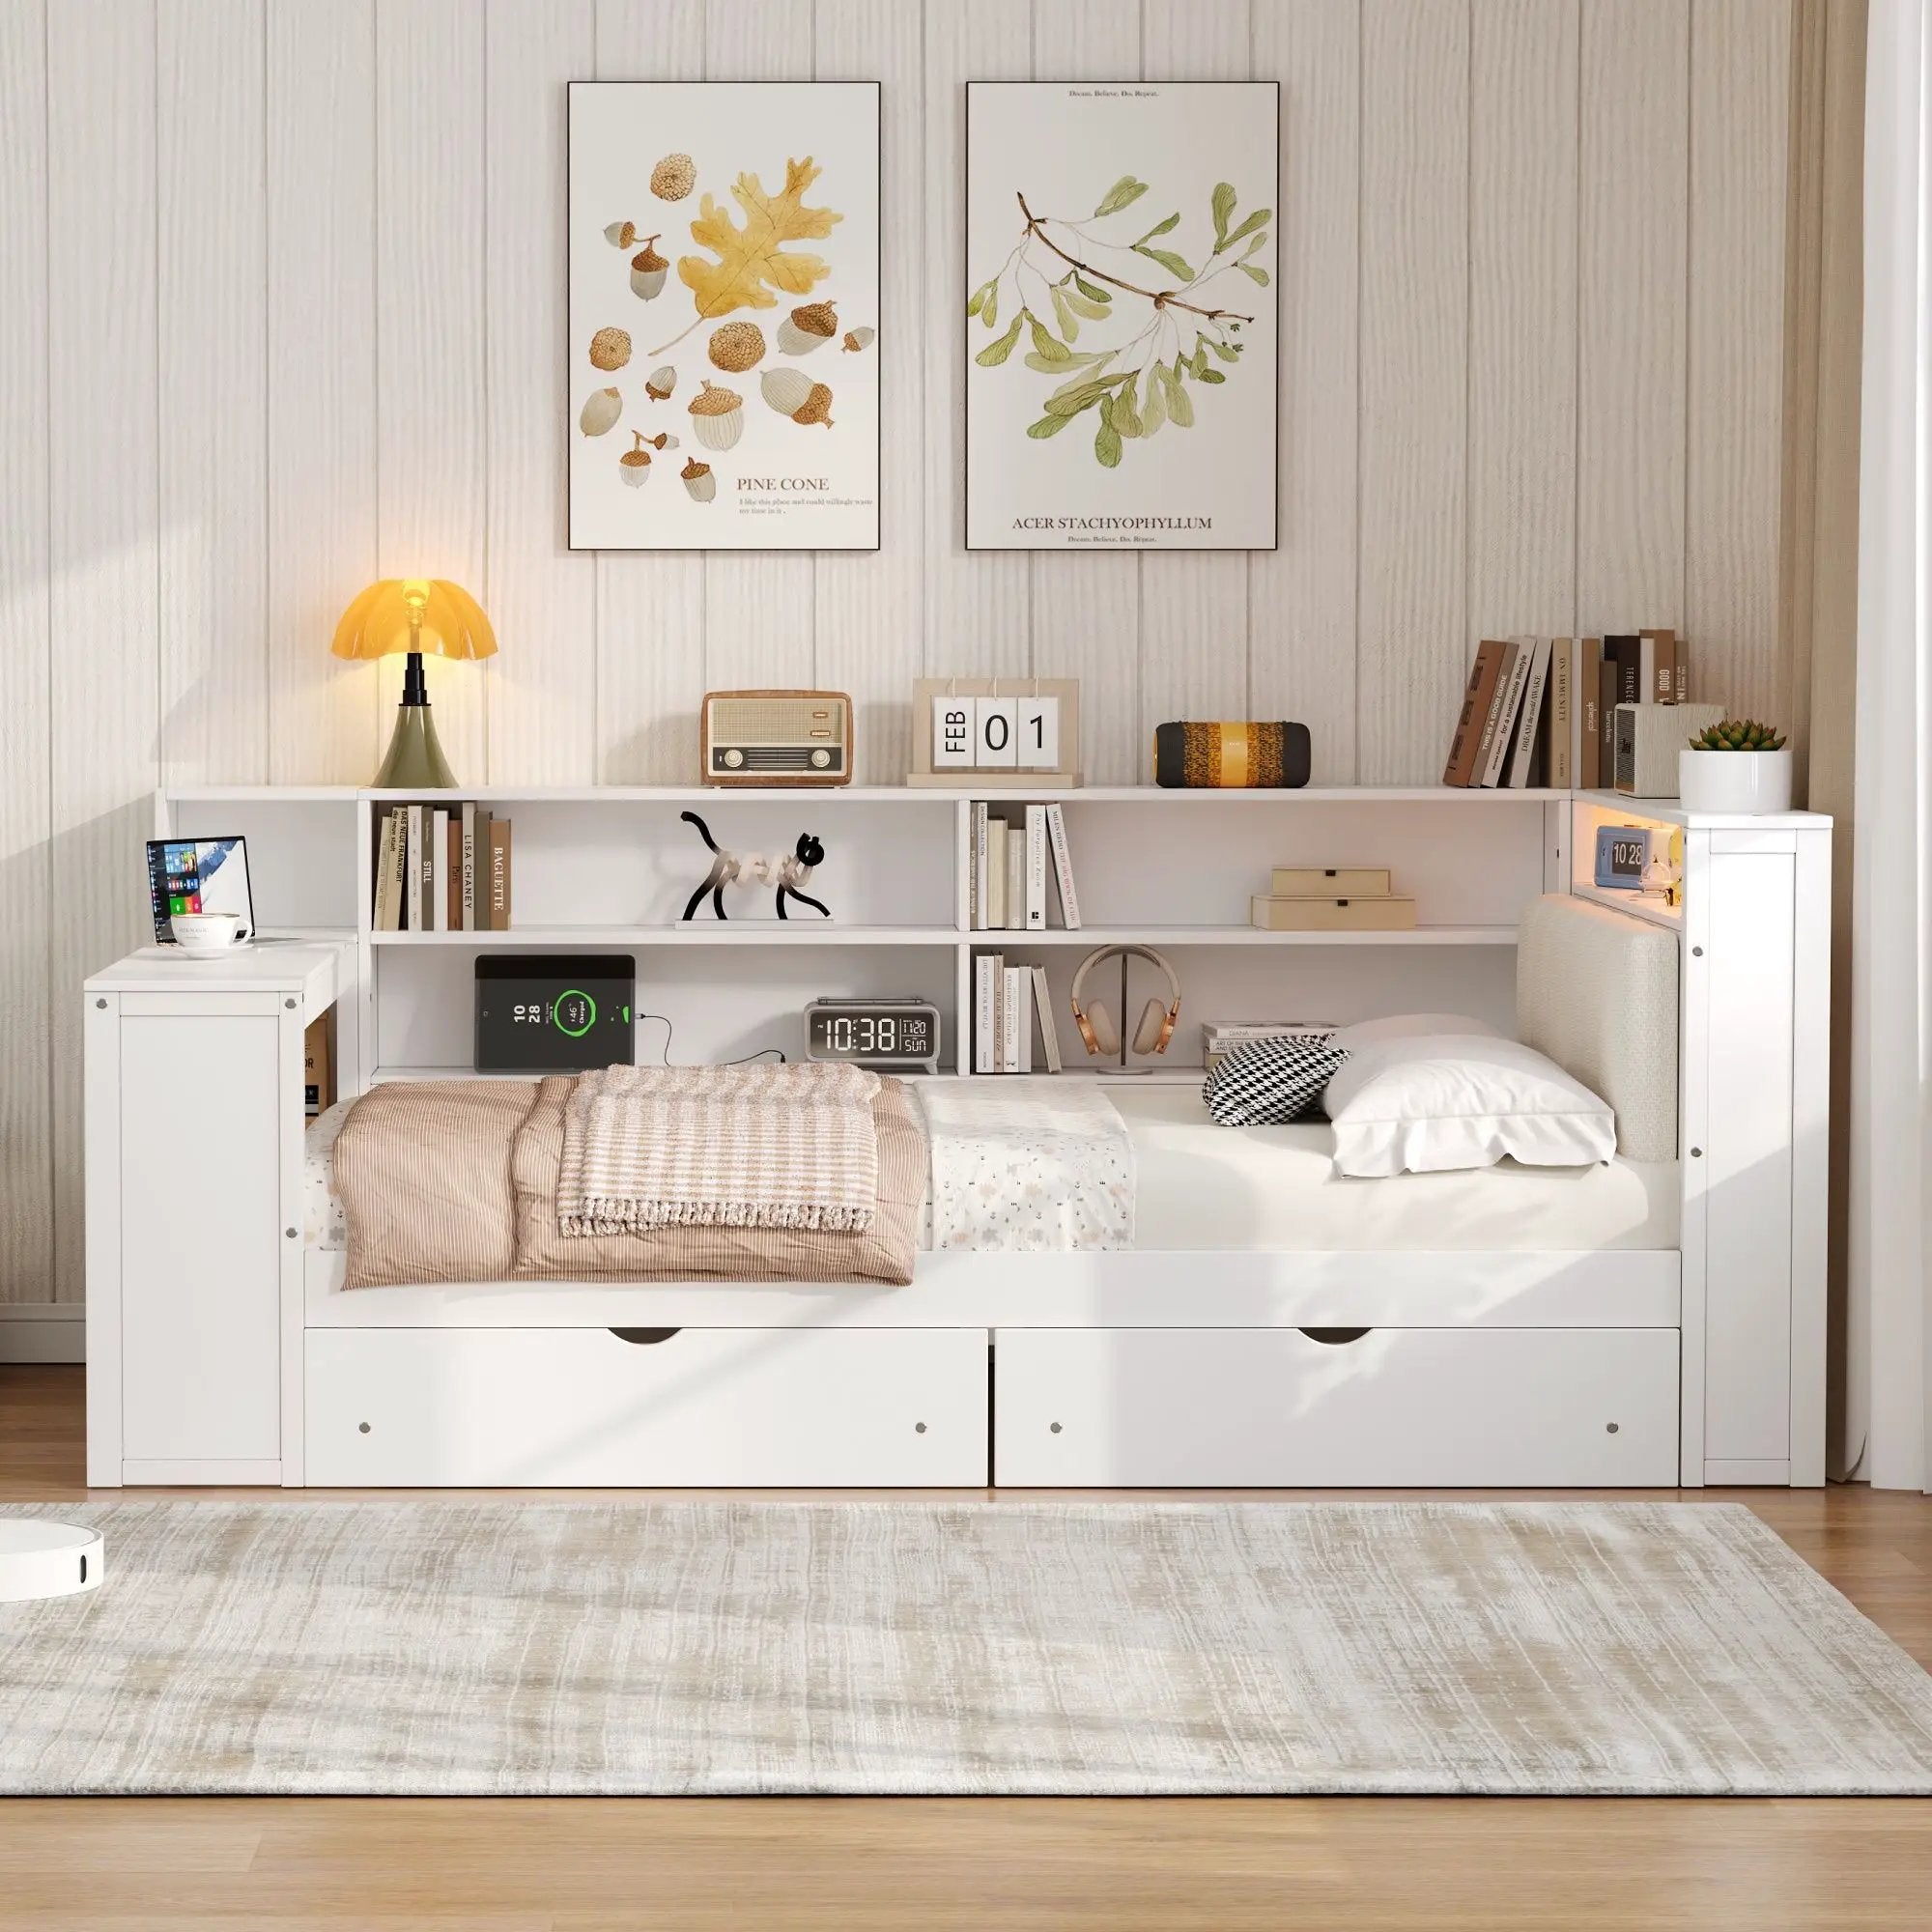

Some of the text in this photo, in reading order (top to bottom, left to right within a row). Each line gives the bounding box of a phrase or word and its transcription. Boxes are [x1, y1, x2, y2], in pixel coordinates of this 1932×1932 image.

[737, 478, 830, 491] PINE CONE
[1012, 518, 1212, 529] ACER STACHYOPHYLLUM
[1559, 657, 1566, 669] ON
[1507, 680, 1520, 719] sustainable
[1517, 655, 1527, 680] lifestyle
[1625, 667, 1634, 700] TERENCE
[1660, 669, 1670, 692] GOOD
[1482, 732, 1492, 750] THIS
[1492, 697, 1501, 719] GOOD
[1497, 674, 1507, 697] GUIDE
[1522, 724, 1533, 752] DREAM
[1531, 675, 1542, 700] AWAKE
[946, 712, 965, 752] FEB
[396, 845, 405, 882] FRANKFURT
[1614, 844, 1642, 866] 10 28
[423, 861, 432, 883] STILL
[464, 835, 472, 909] LISA CHANEY
[495, 847, 503, 911] BAGUETTE
[514, 1006, 526, 1022] 10
[528, 1006, 540, 1023] 28
[827, 1018, 895, 1051] 10:38
[905, 1039, 926, 1051] SUN
